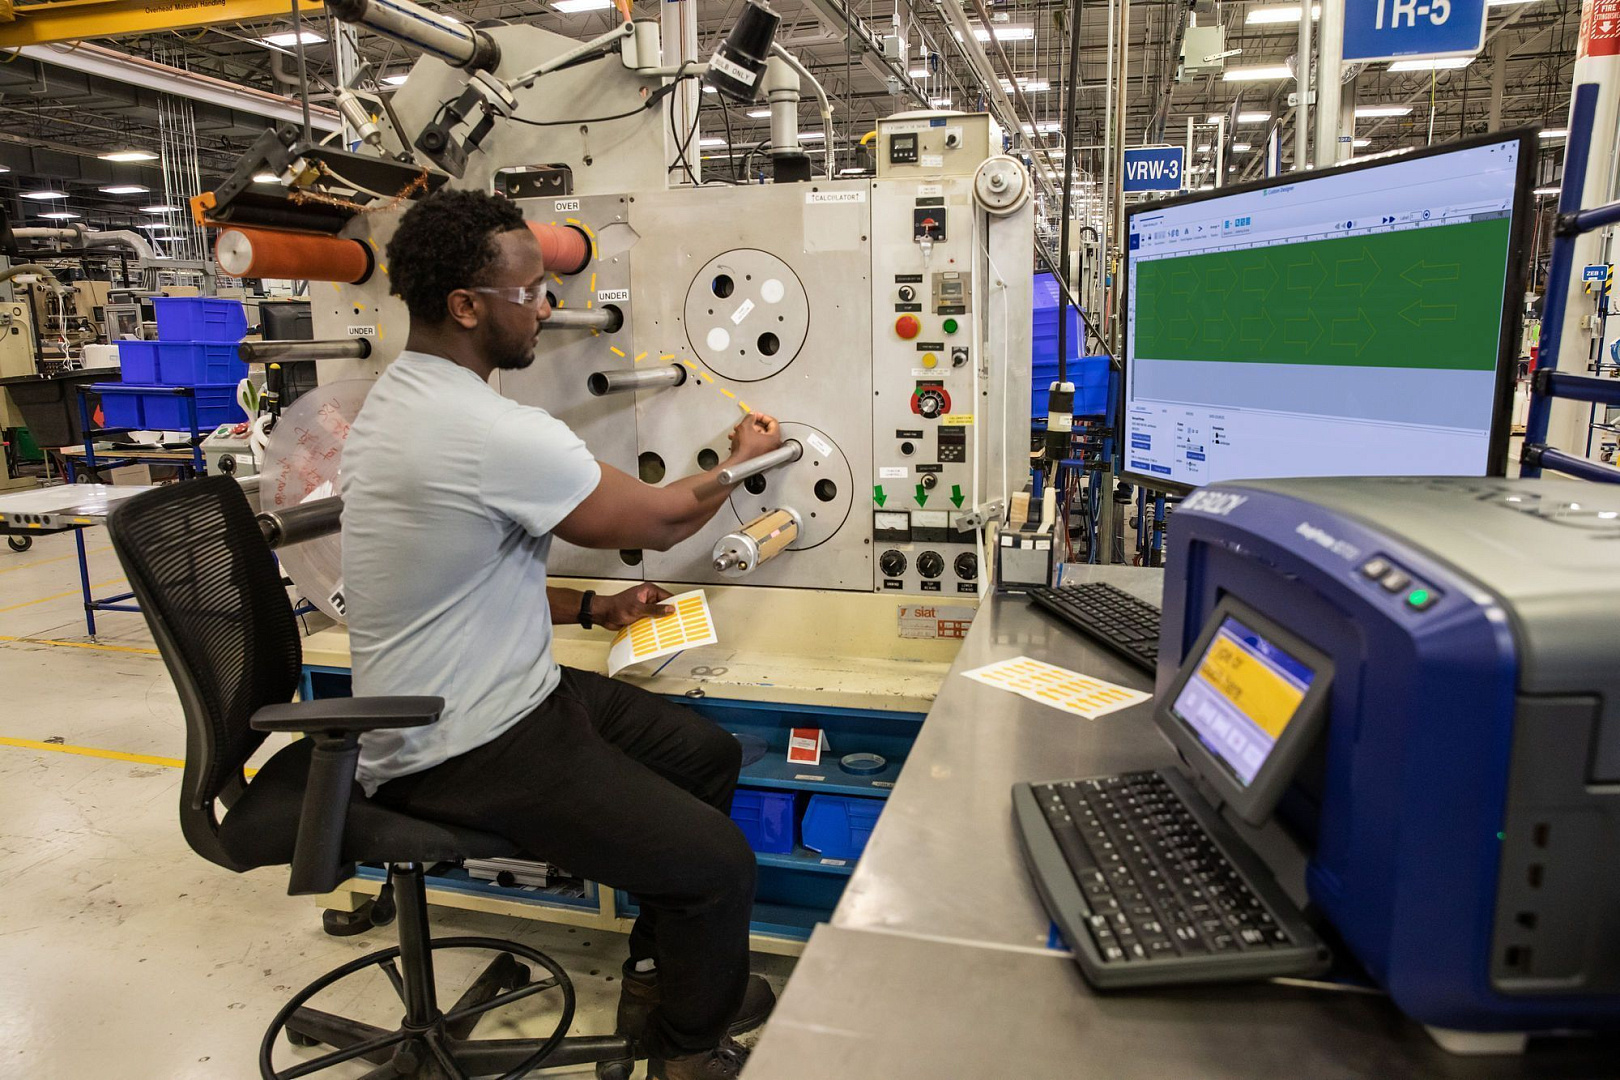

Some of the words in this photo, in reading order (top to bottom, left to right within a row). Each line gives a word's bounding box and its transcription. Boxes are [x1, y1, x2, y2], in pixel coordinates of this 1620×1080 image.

[1601, 4, 1617, 12] FIRE
[732, 68, 750, 80] ONLY
[1126, 160, 1179, 180] VRW-3
[556, 202, 578, 211] OVER
[599, 292, 628, 300] UNDER
[349, 327, 374, 335] UNDER
[914, 606, 936, 618] siat
